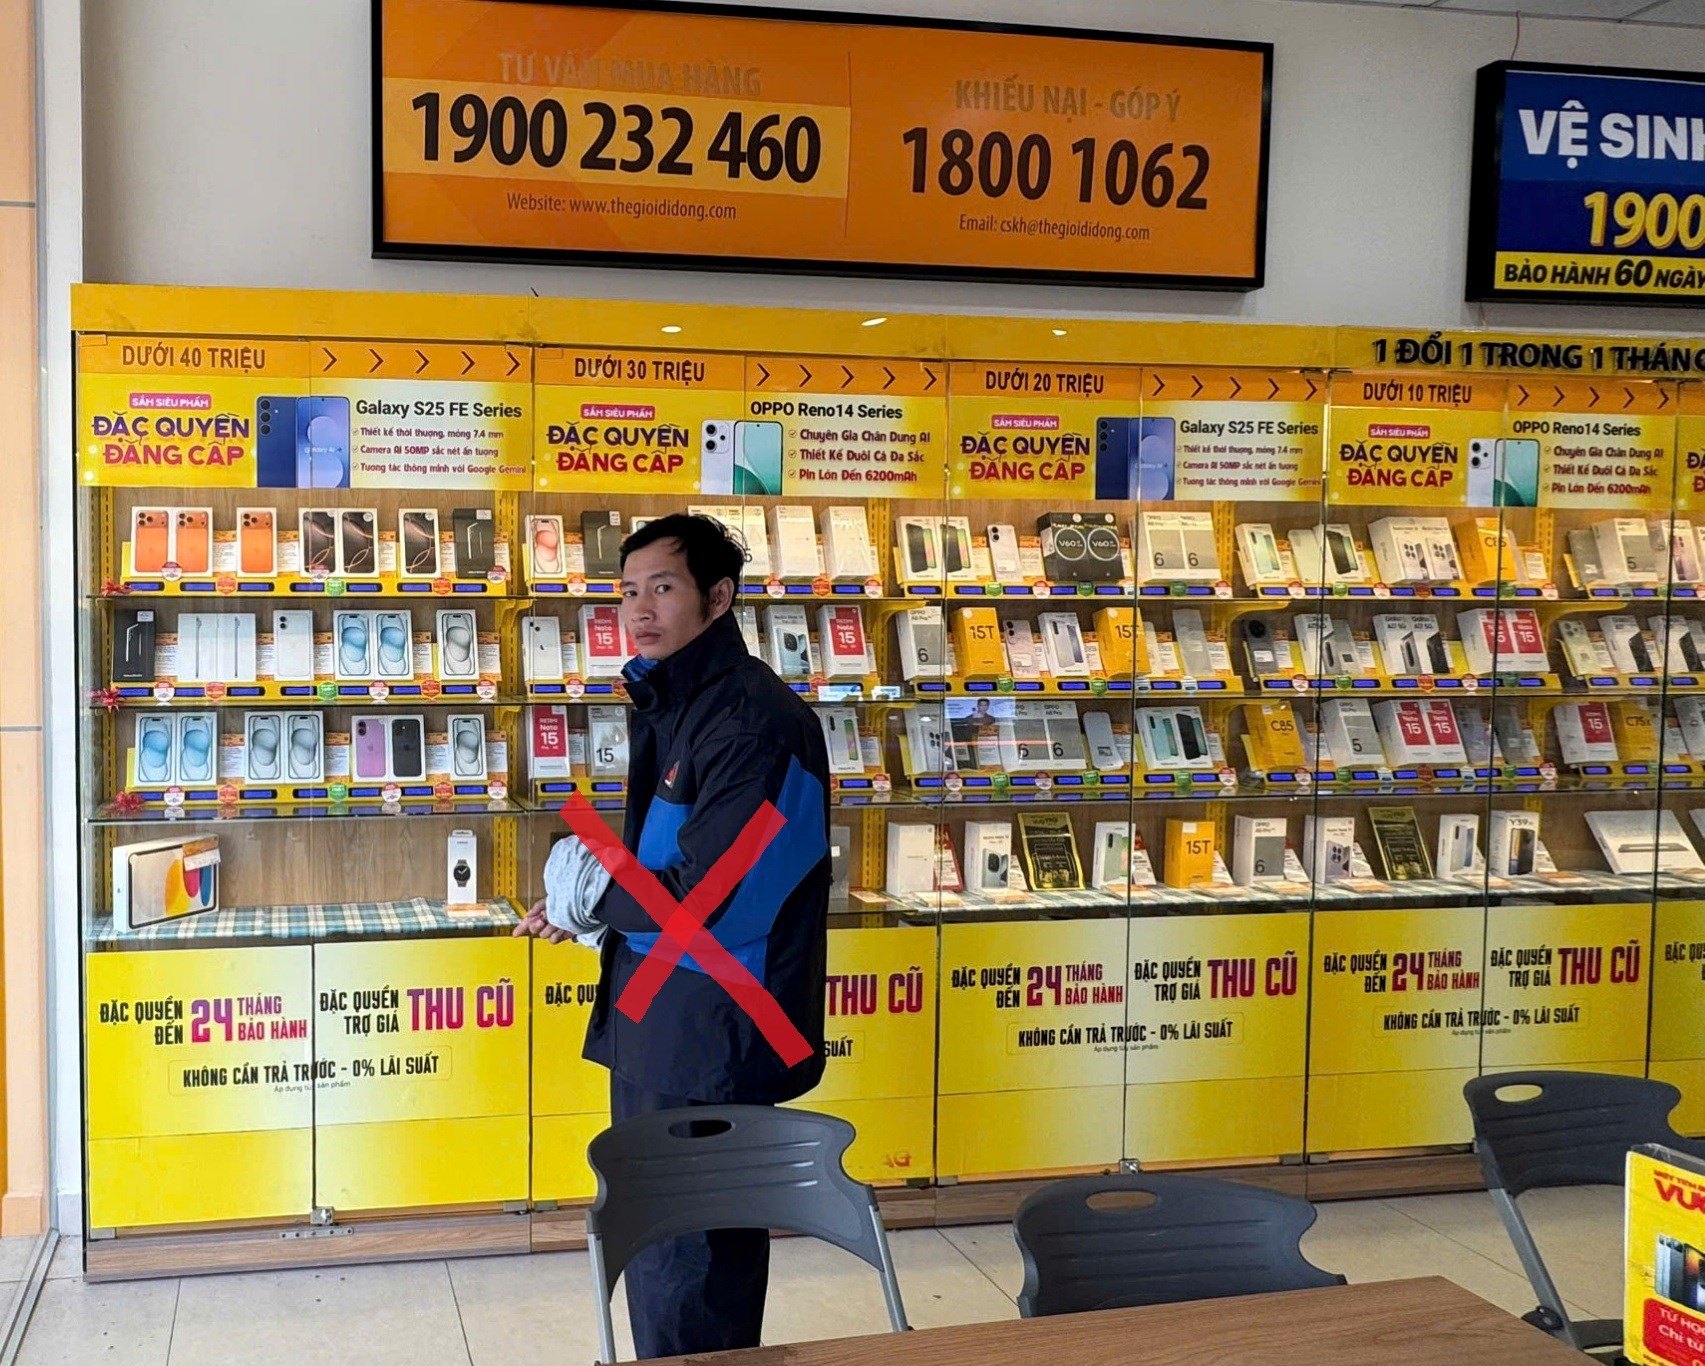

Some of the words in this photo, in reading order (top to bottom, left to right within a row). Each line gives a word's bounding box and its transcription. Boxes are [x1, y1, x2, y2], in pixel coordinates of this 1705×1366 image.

[956, 74, 1034, 111] KHIẾU
[1043, 86, 1086, 123] NẠI
[412, 92, 567, 167] 1900
[580, 102, 693, 175] 232
[707, 111, 821, 183] 460
[1519, 100, 1588, 169] VỆ
[903, 127, 1052, 200] 1800
[1071, 137, 1210, 210] 1062
[507, 192, 565, 214] Website:
[570, 197, 736, 222] www.thegioididong.com
[960, 214, 997, 233] Email:
[1000, 219, 1150, 242] cskh@thegioididong.com
[1584, 191, 1705, 251] 1900
[1503, 258, 1547, 283] BẢO
[1550, 259, 1611, 285] HÀNH
[1613, 259, 1653, 287] 60
[122, 342, 174, 366] DƯỚI
[180, 348, 201, 367] 40
[208, 346, 266, 373] TRIỆU
[1372, 338, 1387, 363] 1
[1395, 331, 1453, 365] ĐỔI
[1460, 342, 1473, 366] 1
[1480, 343, 1583, 368] TRONG
[1591, 346, 1603, 369] 1
[575, 354, 622, 378] DƯỚI
[627, 359, 646, 379] 30
[652, 359, 705, 386] TRIỆU
[986, 369, 1029, 392] DƯỚI
[1033, 374, 1051, 392] 20
[1056, 373, 1104, 398] TRIỆU
[1363, 380, 1403, 401] DƯỚI
[1408, 383, 1424, 402] 10
[1428, 384, 1472, 408] TRIỆU
[356, 400, 410, 419] Galaxy
[414, 401, 444, 416] S25
[450, 402, 468, 416] FE
[473, 403, 522, 418] Series
[751, 402, 794, 416] OPPO
[798, 403, 854, 417] Reno14
[858, 404, 903, 419] Series
[92, 410, 149, 443] ĐẶC
[156, 413, 249, 438] QUYỀN
[546, 421, 598, 451] ĐẶC
[604, 423, 689, 447] QUYỀN
[800, 429, 838, 442] Chuyên
[862, 430, 887, 442] Chân
[890, 432, 916, 445] Dung
[1180, 420, 1225, 437] Galaxy
[1228, 421, 1254, 434] S25
[1258, 422, 1274, 434] FE
[1278, 422, 1318, 435] Series
[1513, 420, 1550, 433] OPPO
[1553, 422, 1600, 435] Reno14
[1603, 423, 1641, 436] Series
[188, 437, 244, 466] CẤP
[361, 445, 391, 454] Camera
[405, 446, 429, 455] 50MP
[800, 449, 826, 460] Thiết
[829, 450, 843, 461] Kế
[960, 432, 1008, 460] ĐẶC
[1012, 433, 1090, 456] QUYỀN
[1387, 441, 1458, 465] QUYỀN
[633, 447, 684, 473] CẤP
[1038, 457, 1086, 481] CẤP
[865, 470, 917, 482] 6200mAh
[1154, 552, 1164, 566] 6
[1188, 552, 1199, 566] 6
[1627, 557, 1636, 570] 5
[595, 633, 614, 645] 15
[838, 632, 856, 644] 15
[969, 625, 994, 640] 15T
[918, 648, 928, 662] 6
[1405, 722, 1421, 734] 15
[1434, 722, 1451, 734] 15
[1588, 718, 1603, 730] 15
[540, 732, 559, 745] 15
[1053, 743, 1064, 757] 6
[1352, 739, 1362, 752] 5
[596, 747, 614, 763] 15
[1186, 840, 1211, 854] 15T
[1255, 859, 1265, 874] 6
[1207, 958, 1256, 999] THU
[1265, 950, 1297, 996] CŨ
[1392, 952, 1424, 992] 24
[825, 975, 876, 1017] THU
[888, 966, 923, 1013] CŨ
[1027, 965, 1062, 1007] 24
[100, 998, 129, 1026] ĐẶC
[135, 995, 183, 1024] QUYỀN
[237, 992, 282, 1016] THÁNG
[320, 989, 347, 1014] ĐẶC
[353, 985, 399, 1013] QUYỀN
[406, 986, 464, 1031] THU
[476, 978, 514, 1028] CŨ
[154, 1020, 183, 1045] ĐẾN
[191, 998, 233, 1043] 24
[238, 1017, 265, 1041] BẢO
[270, 1017, 307, 1039] HÀNH
[344, 1015, 370, 1036] TRỢ
[376, 1010, 399, 1033] GIÁ
[183, 1066, 228, 1087] KHÔNG
[232, 1062, 259, 1084] CẦN
[264, 1060, 289, 1084] TRẢ
[352, 1058, 375, 1076] 0%
[380, 1054, 400, 1076] LÃI
[406, 1051, 439, 1074] SUẤT
